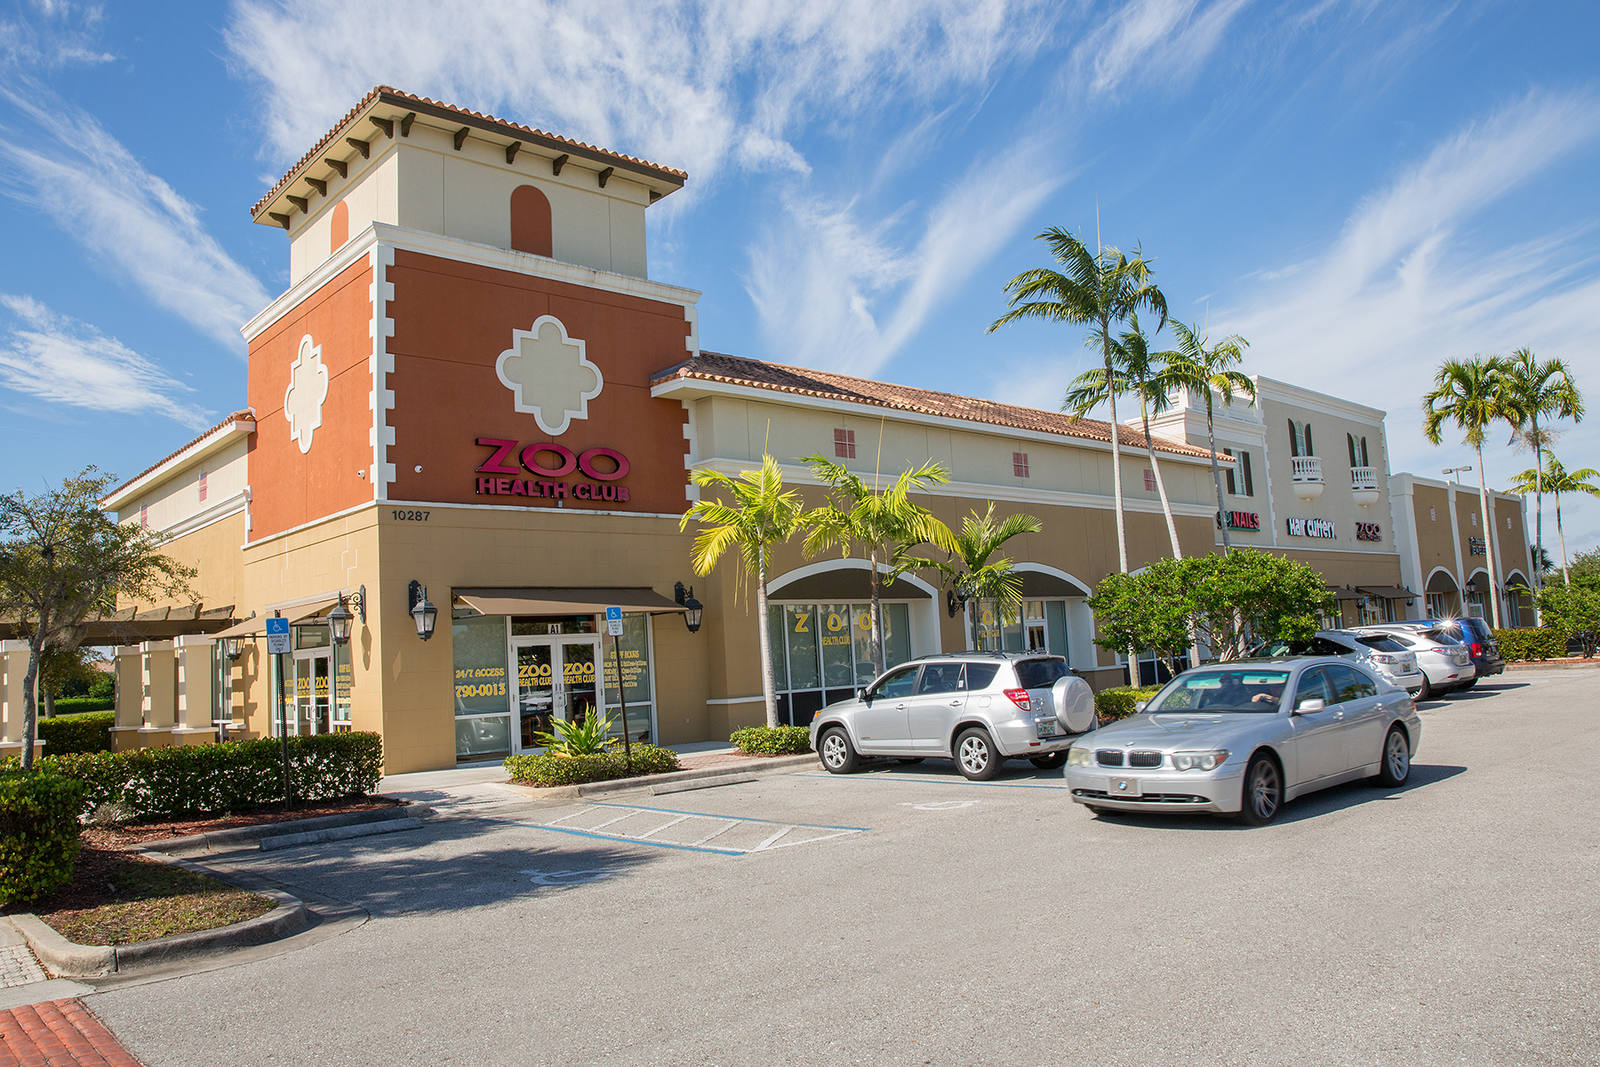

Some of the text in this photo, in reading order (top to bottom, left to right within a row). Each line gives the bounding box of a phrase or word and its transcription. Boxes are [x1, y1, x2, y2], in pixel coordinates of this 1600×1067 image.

[475, 437, 630, 481] ZOO
[476, 477, 630, 502] HEALTH CLUB
[392, 510, 431, 522] 10287
[1232, 511, 1260, 529] NAILS
[1288, 517, 1306, 537] Hair
[550, 624, 559, 634] A1
[455, 667, 505, 679] 24/7 ACCESS
[518, 663, 552, 678] ZOO
[563, 661, 595, 675] ZOO
[297, 677, 310, 689] ZOO
[315, 676, 328, 689] ZOO
[519, 676, 552, 687] HEALTH CLUB
[563, 675, 583, 685] HEALTH
[582, 674, 596, 684] CLUB
[455, 682, 506, 698] 790-0013
